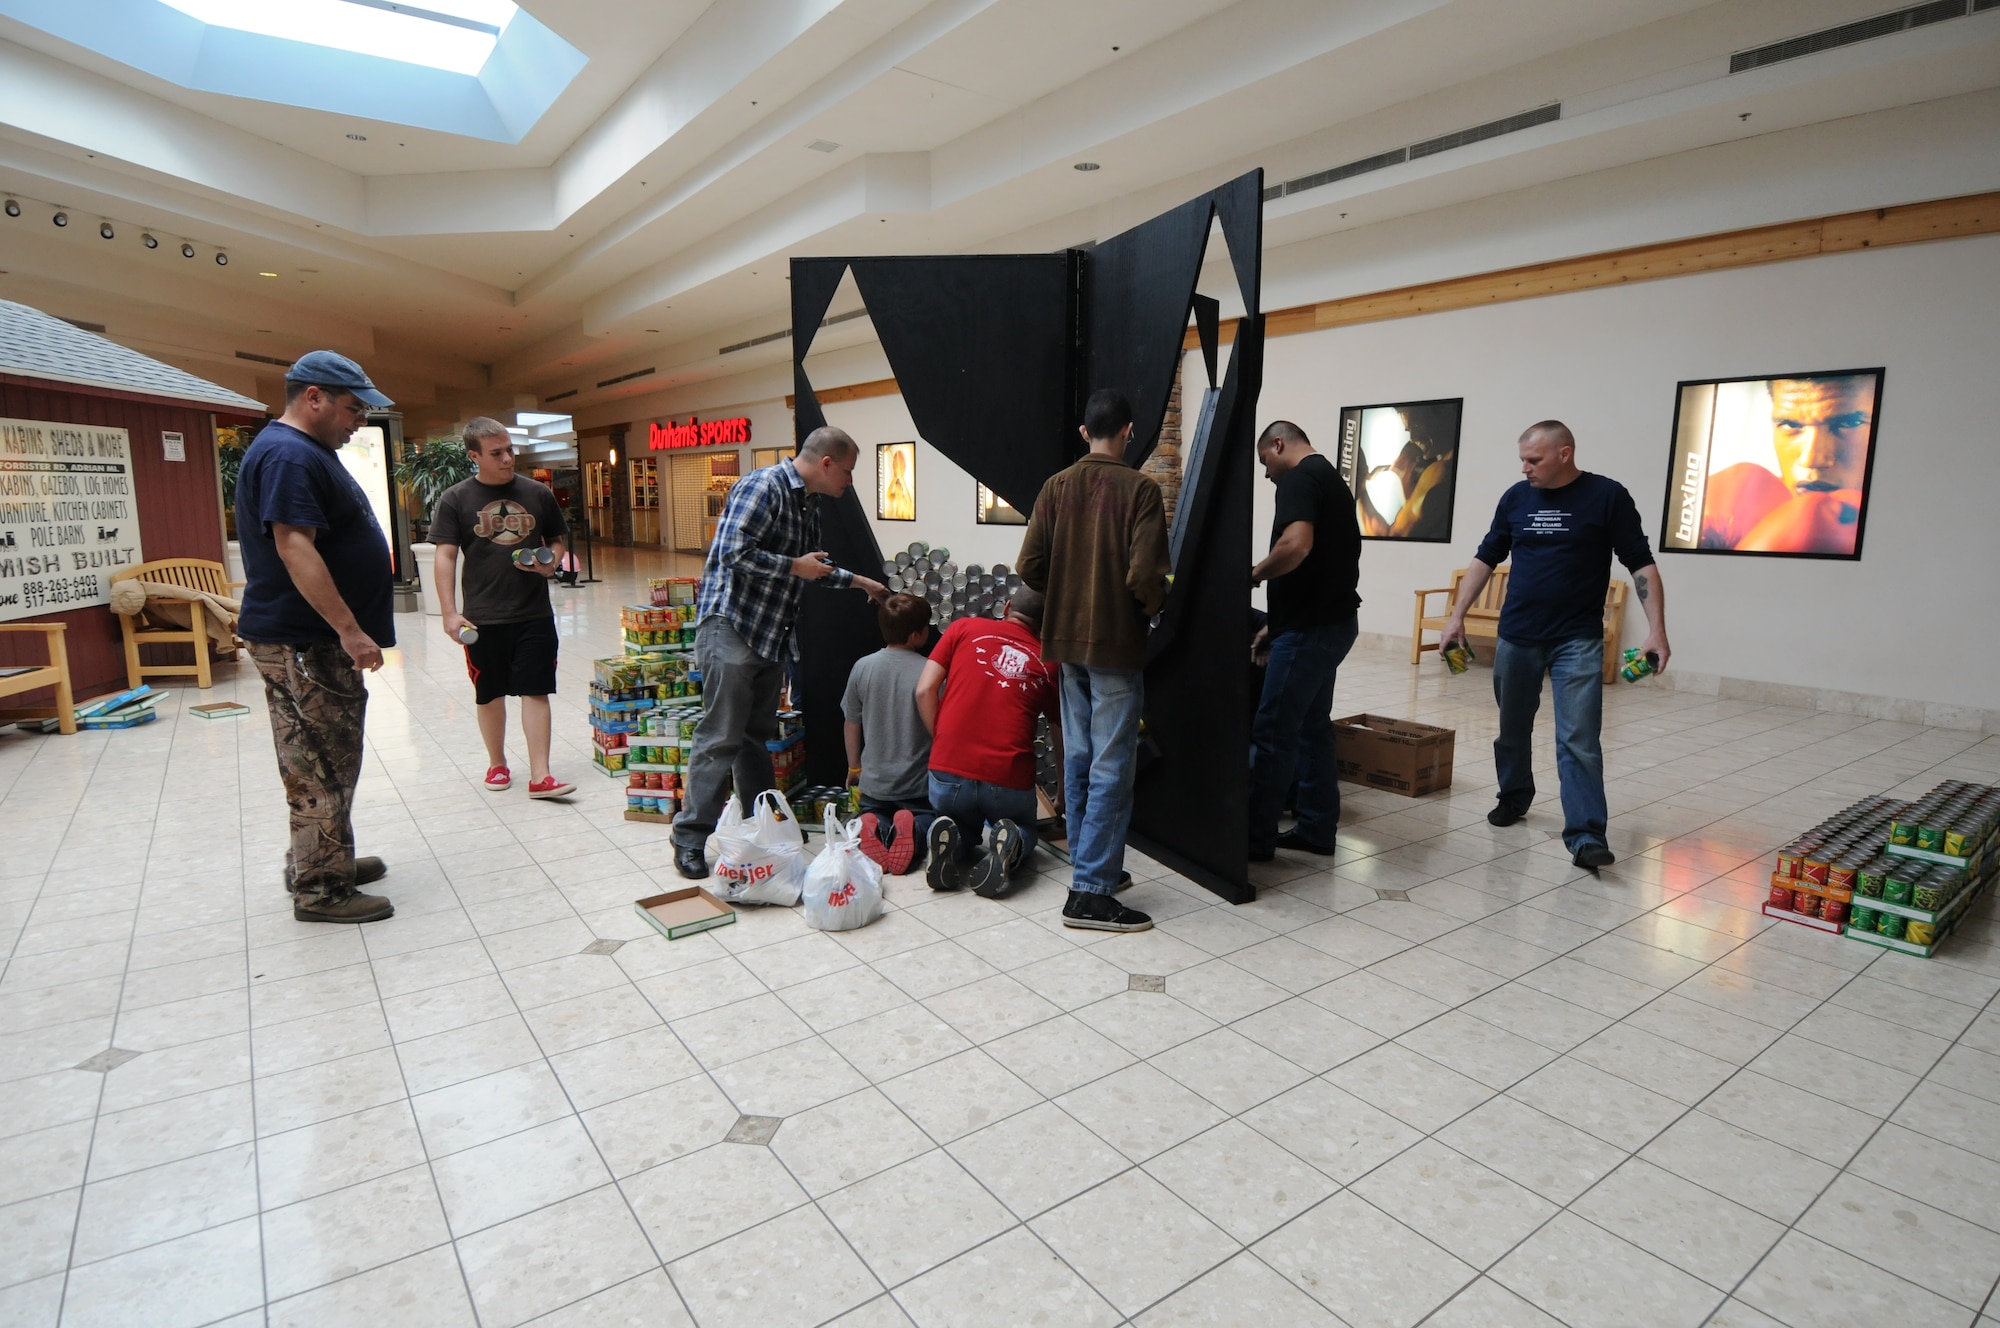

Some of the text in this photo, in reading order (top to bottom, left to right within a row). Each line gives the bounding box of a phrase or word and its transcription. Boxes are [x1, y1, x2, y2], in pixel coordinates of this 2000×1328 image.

[2, 425, 124, 459] KABINS, SHEDS & MORE
[649, 416, 748, 450] Dunham's SPORTS
[1342, 418, 1357, 470] lifting
[0, 461, 51, 471] FORRISTER
[71, 464, 105, 472] ADRIAN
[0, 475, 129, 498] KABINS, GAZEBOS, LOG HOMES
[1675, 451, 1704, 543] boxing
[0, 500, 128, 525] URNITURE, KITCHEN CABINETS
[473, 511, 536, 537] Jeep
[30, 524, 86, 548] POLE BARNS
[0, 547, 135, 578] MISH BUILT
[0, 586, 99, 608] one 517-403-0444
[23, 574, 98, 595] 888-263-6403
[715, 862, 774, 884] meijer
